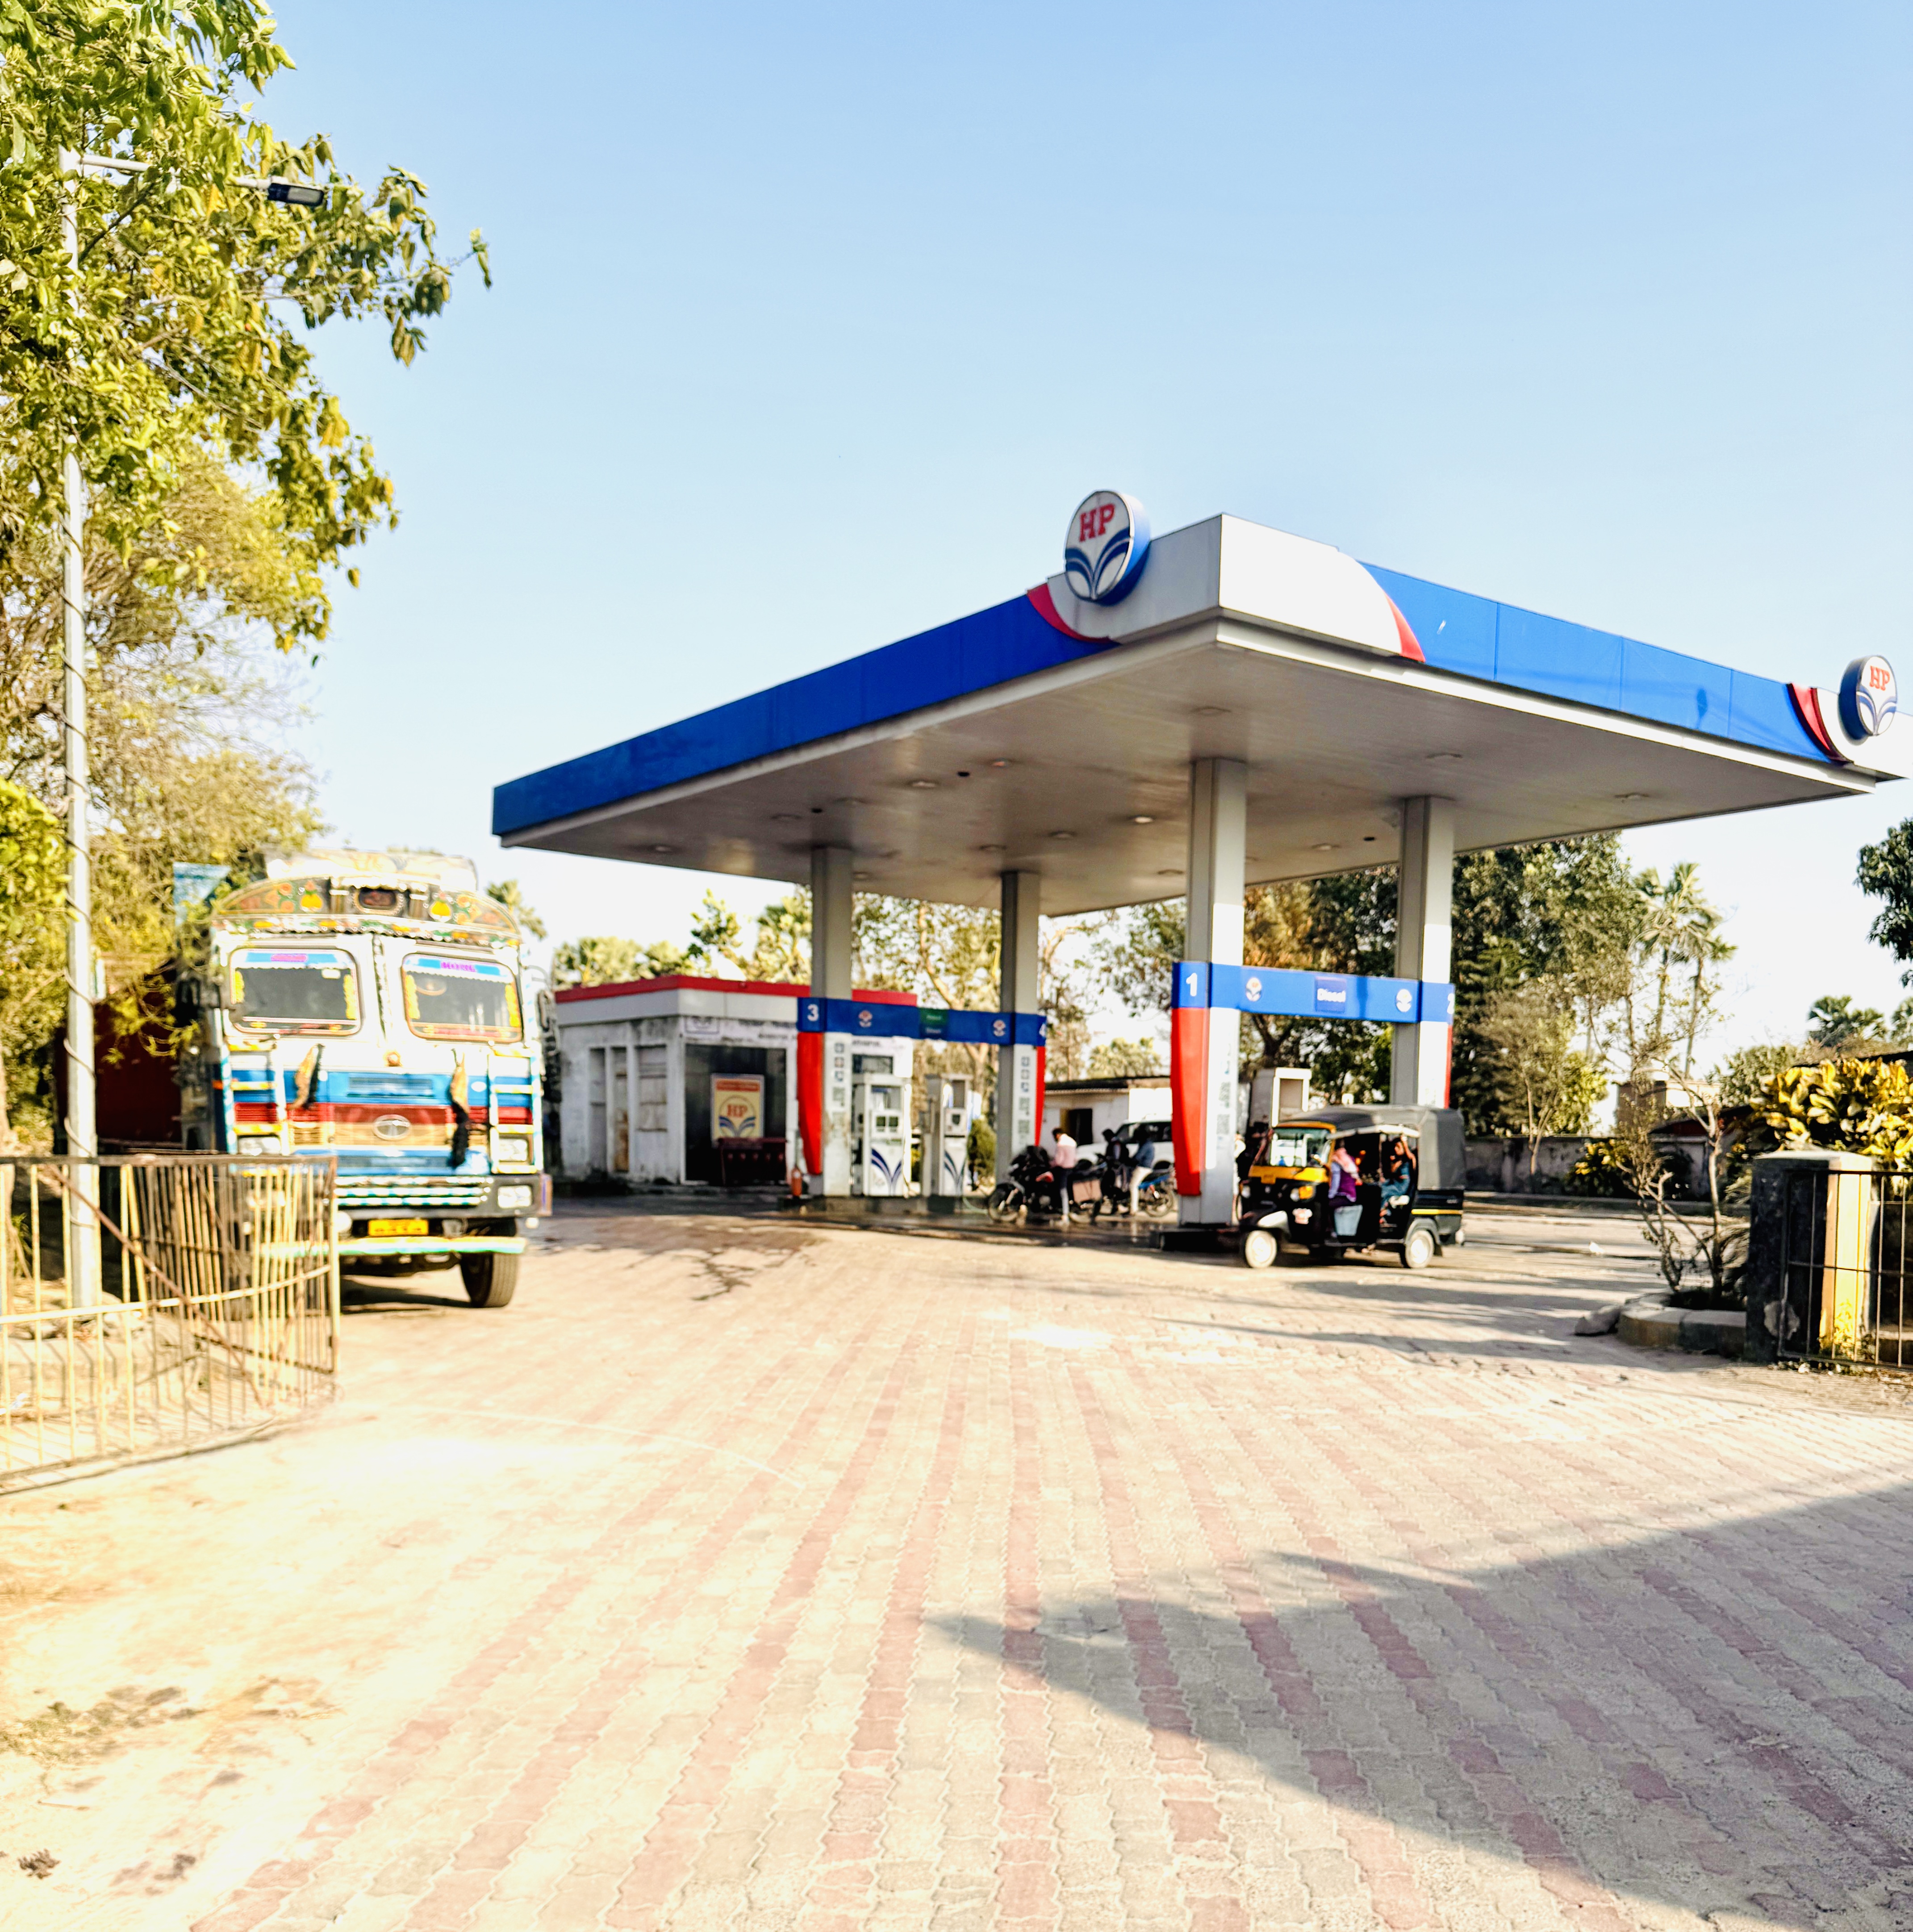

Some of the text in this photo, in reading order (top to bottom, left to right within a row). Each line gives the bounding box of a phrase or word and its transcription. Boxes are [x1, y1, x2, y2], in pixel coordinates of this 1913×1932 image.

[1079, 503, 1115, 542] HP
[1869, 665, 1890, 691] HP
[1186, 973, 1198, 996] 1
[807, 1004, 819, 1021] 3
[727, 1104, 748, 1118] HP
